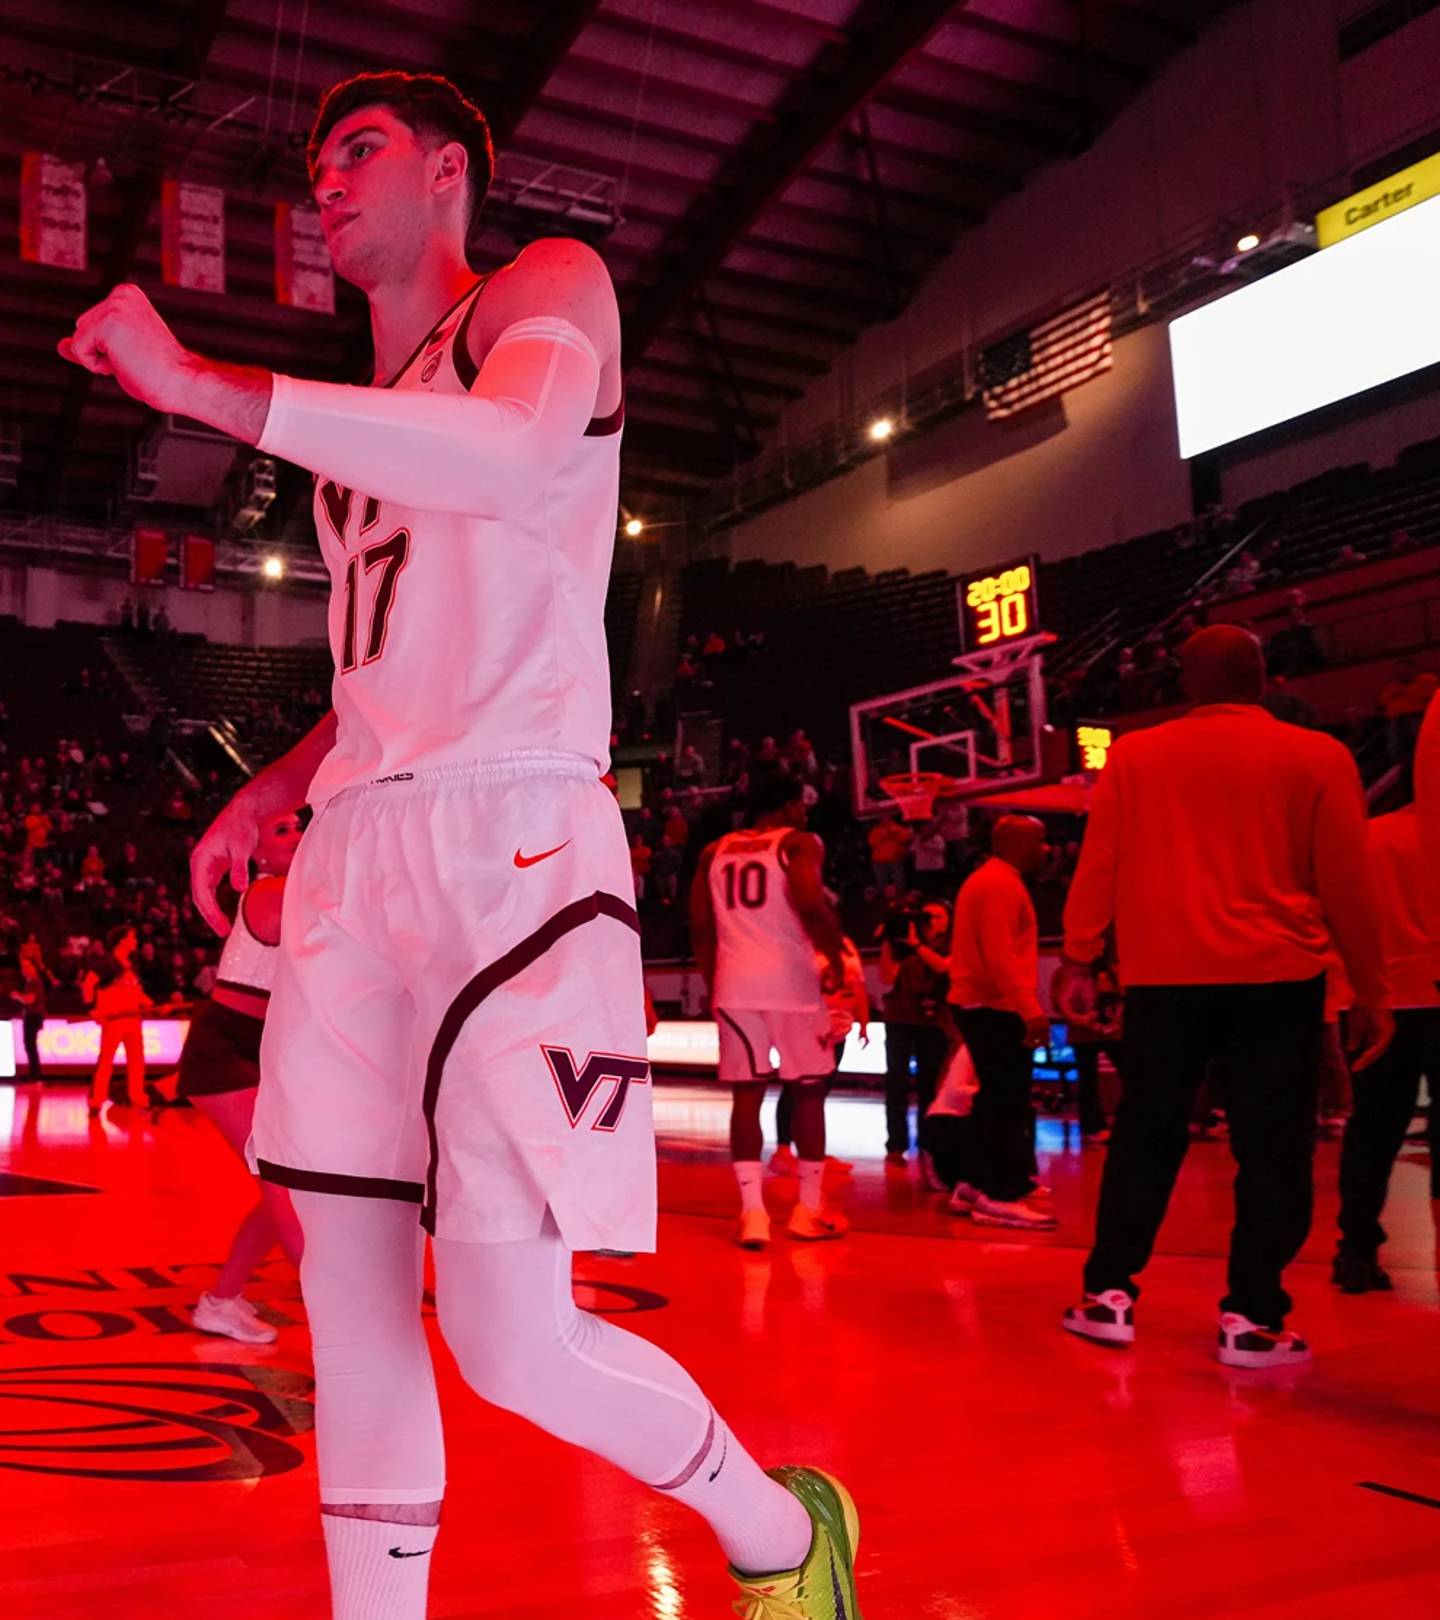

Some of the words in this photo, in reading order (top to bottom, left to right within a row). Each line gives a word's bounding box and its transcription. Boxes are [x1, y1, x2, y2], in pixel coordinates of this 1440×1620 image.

[1344, 182, 1414, 226] Carter
[341, 527, 411, 675] 17
[966, 566, 1030, 606] 20:00
[976, 593, 1026, 644] 30
[721, 861, 767, 911] 10
[540, 1044, 649, 1132] VT
